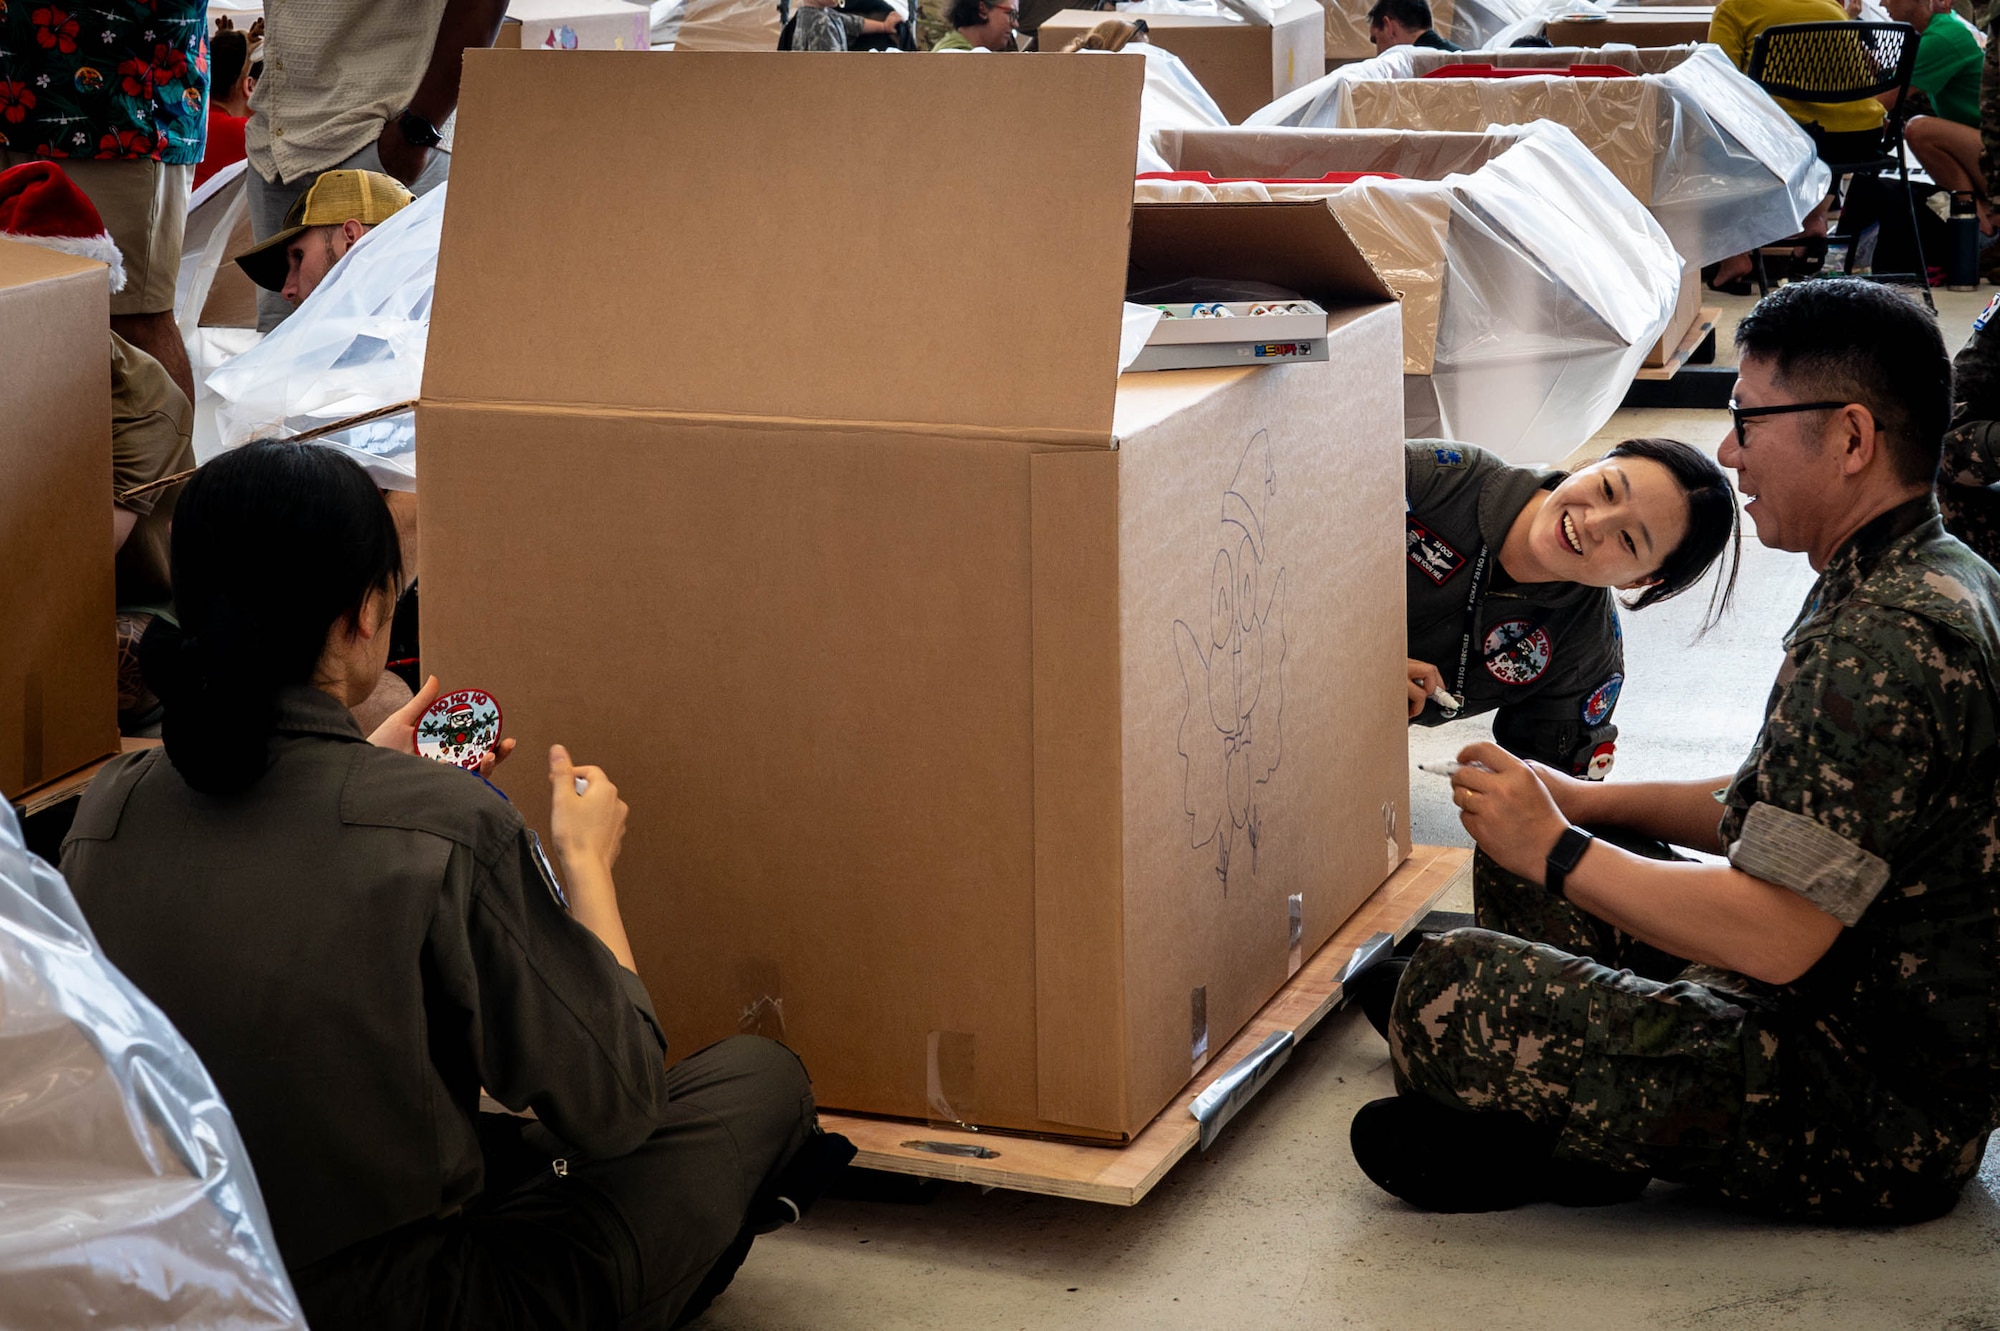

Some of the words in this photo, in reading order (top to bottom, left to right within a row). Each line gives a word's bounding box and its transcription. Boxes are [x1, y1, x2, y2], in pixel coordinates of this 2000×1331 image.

[1460, 634, 1469, 666] HERCULES
[1538, 642, 1548, 657] HO
[429, 700, 449, 717] HO
[450, 692, 469, 705] HO
[470, 692, 487, 706] HO
